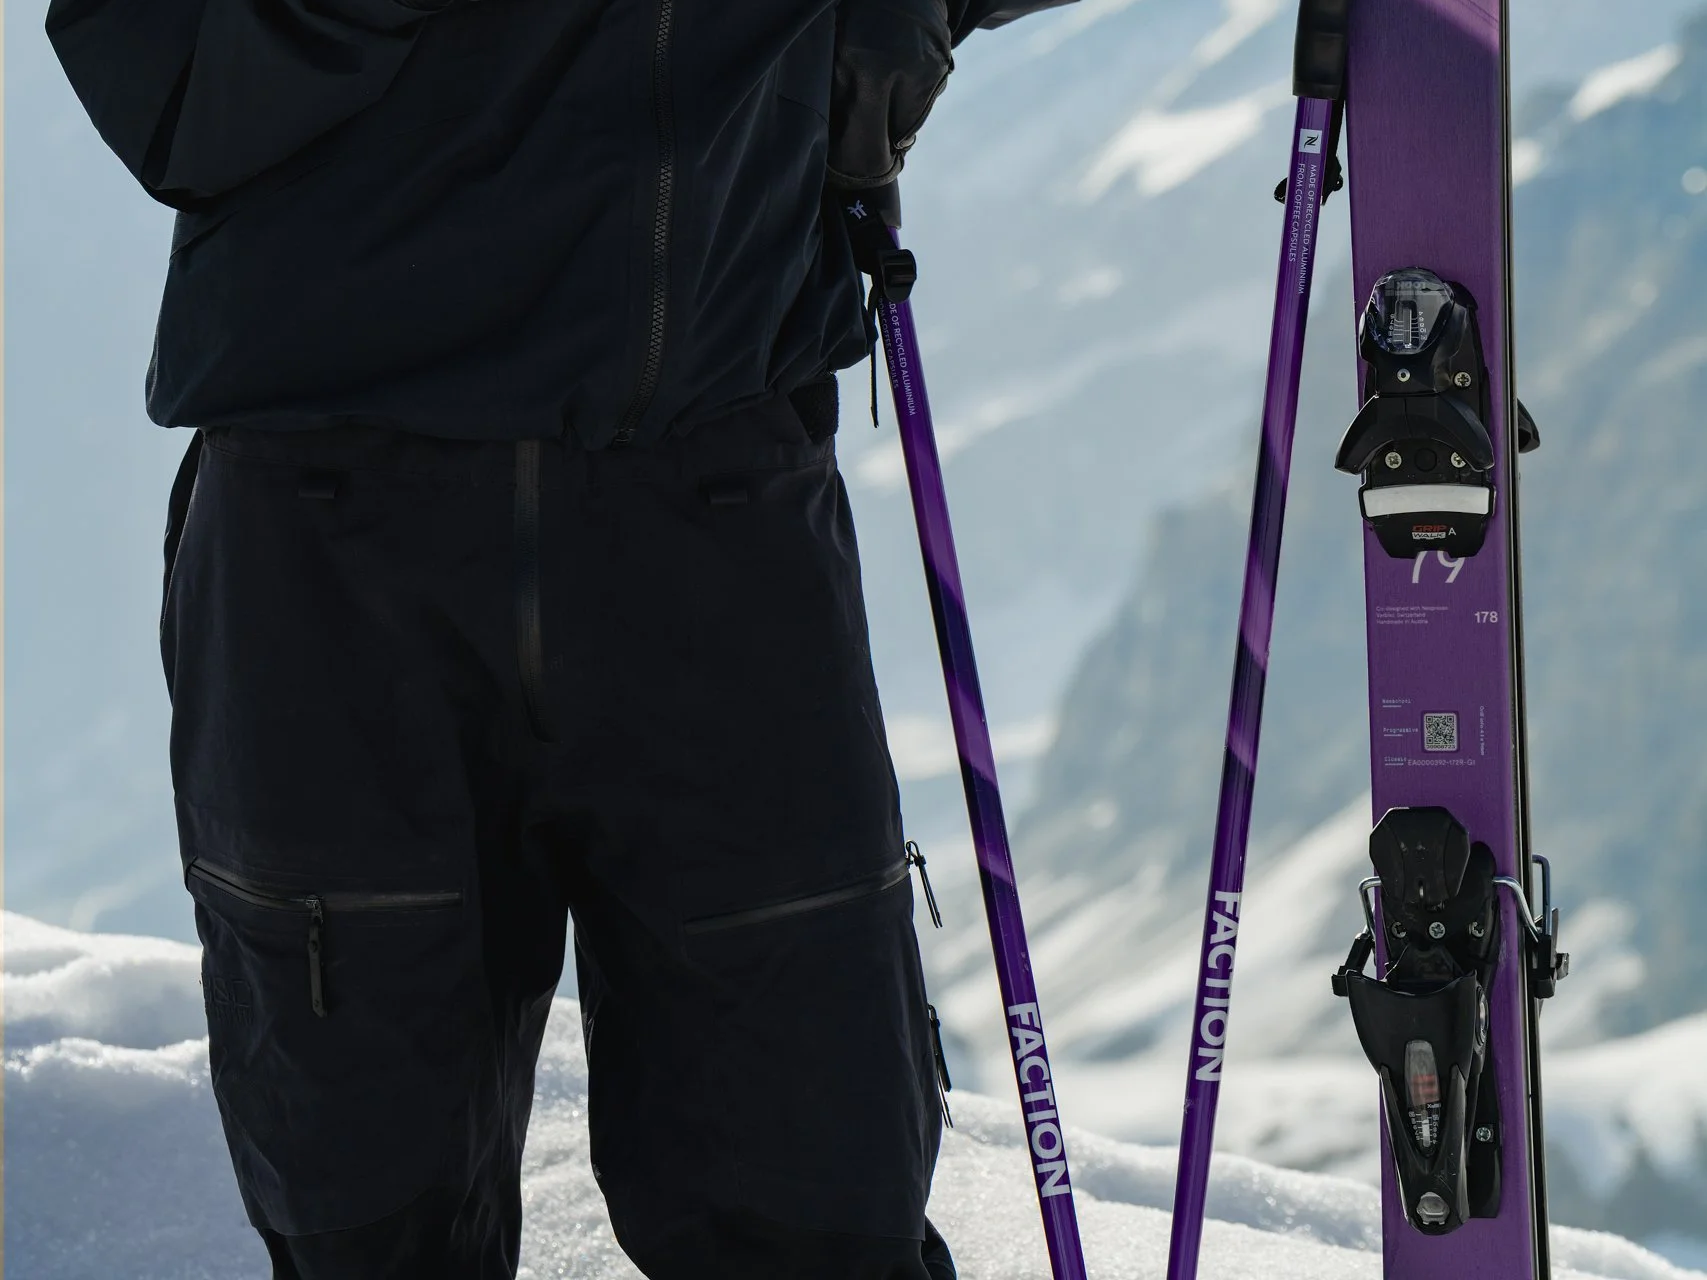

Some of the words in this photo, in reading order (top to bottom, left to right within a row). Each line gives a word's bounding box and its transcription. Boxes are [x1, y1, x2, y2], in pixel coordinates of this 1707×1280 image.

[1296, 163, 1305, 187] FROM
[1308, 164, 1317, 189] MADE
[1292, 189, 1304, 220] COFFEE
[1307, 190, 1315, 202] OF
[1289, 221, 1299, 262] CAPSULES
[1303, 203, 1314, 245] RECYCLED
[1298, 246, 1309, 294] ALUMINIUM
[891, 315, 900, 328] OF
[894, 328, 907, 368] RECYCLED
[901, 369, 916, 417] ALUMINIUM
[1448, 527, 1457, 536] A
[1474, 610, 1498, 624] 178
[1195, 889, 1241, 1082] FACTION
[1007, 1001, 1071, 1198] FACTION
